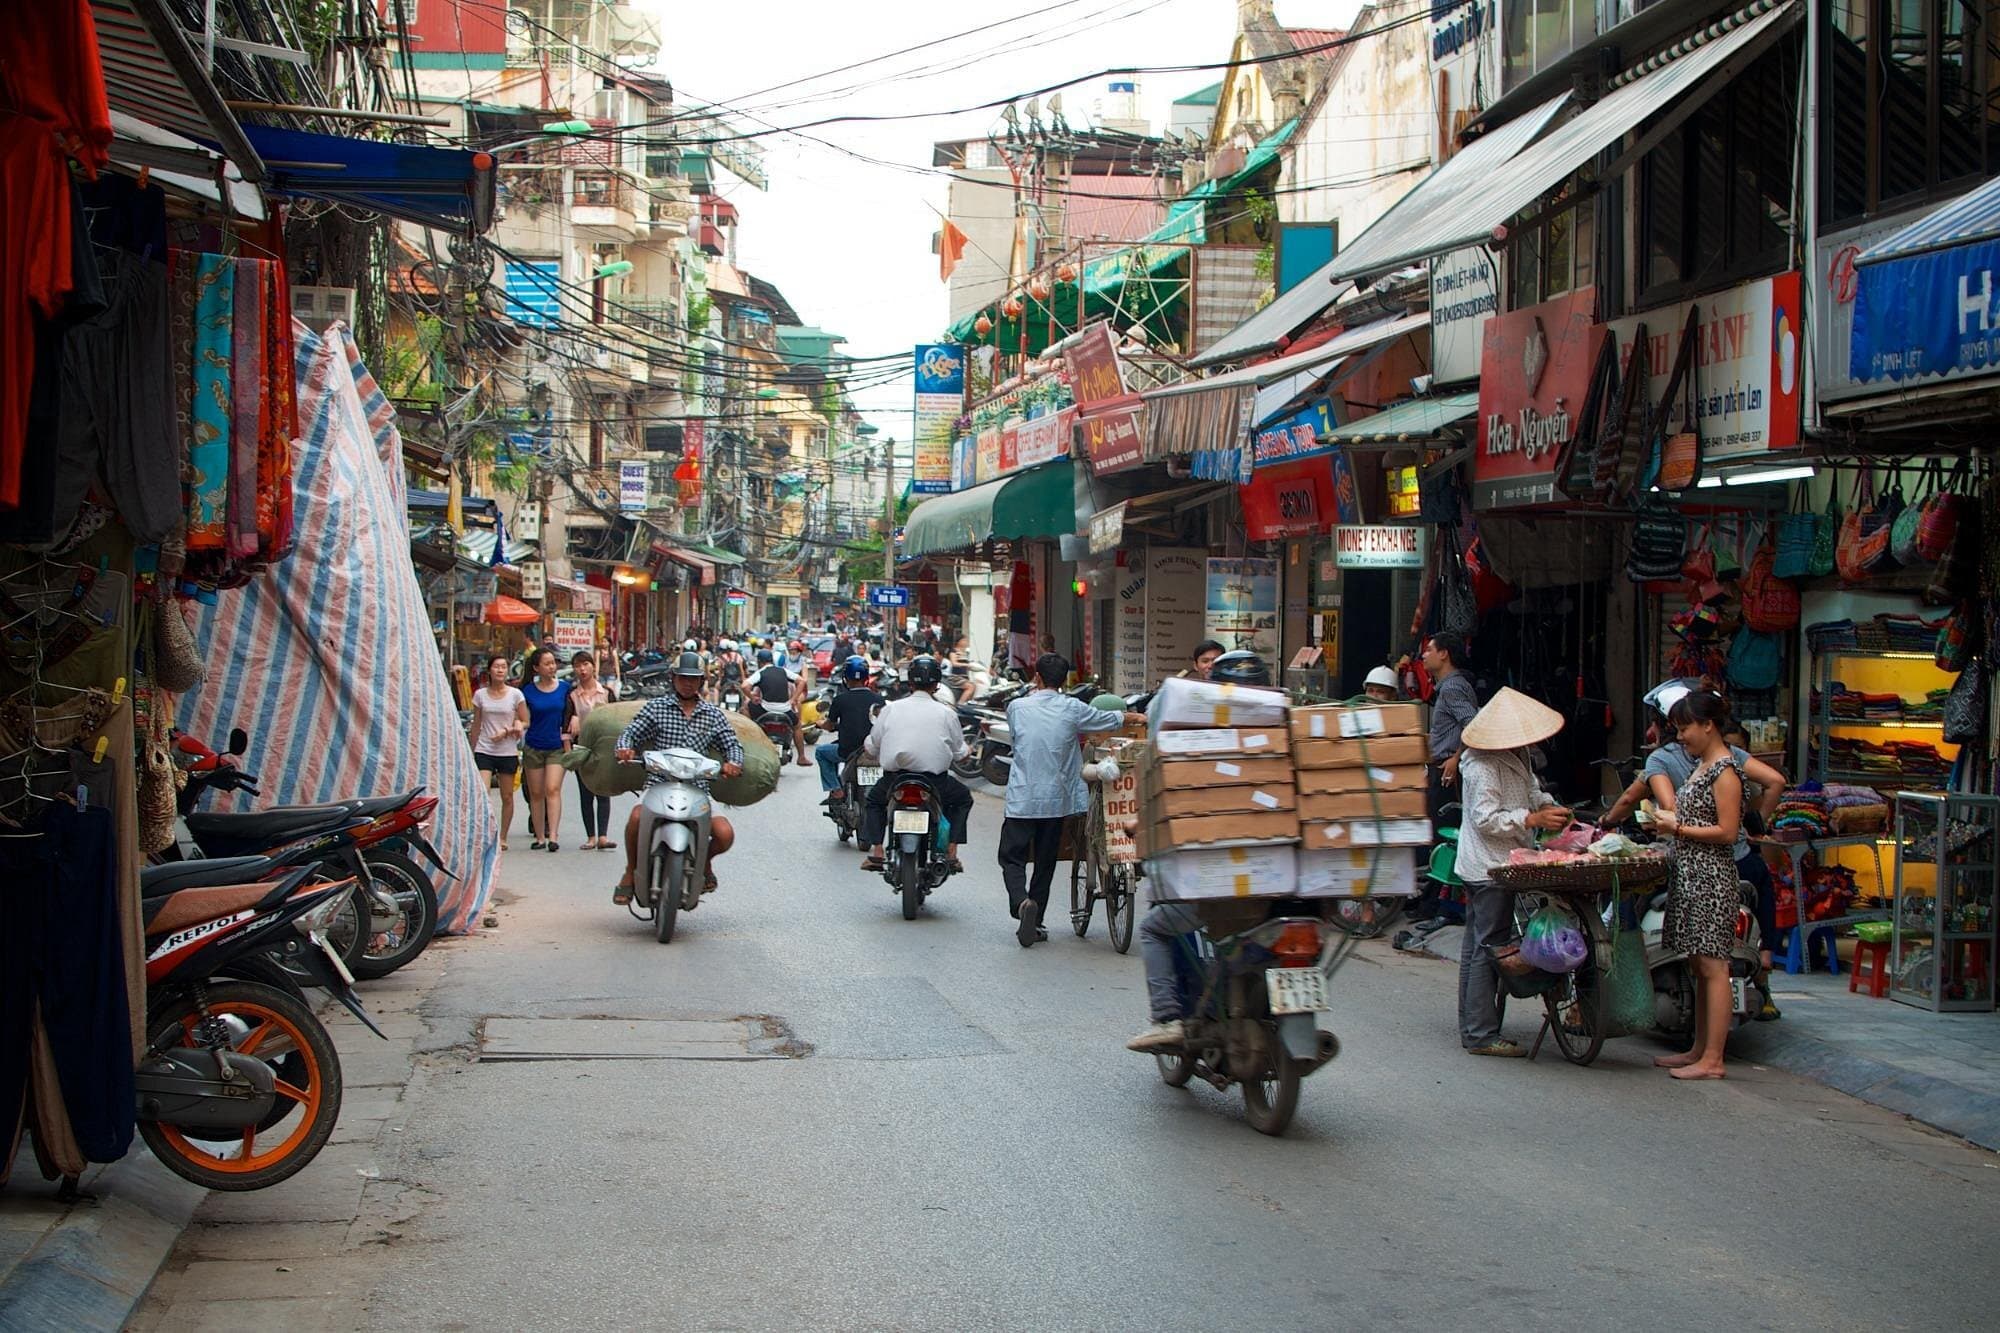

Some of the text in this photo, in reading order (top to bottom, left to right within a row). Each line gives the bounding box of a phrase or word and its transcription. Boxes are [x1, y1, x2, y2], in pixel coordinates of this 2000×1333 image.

[1747, 383, 1762, 410] Len
[1487, 414, 1512, 456] Hoa
[622, 466, 645, 477] GUEST
[621, 480, 645, 492] HOUSE
[1338, 527, 1417, 552] MONEY EXCHANGE
[166, 914, 241, 950] REPSOL
